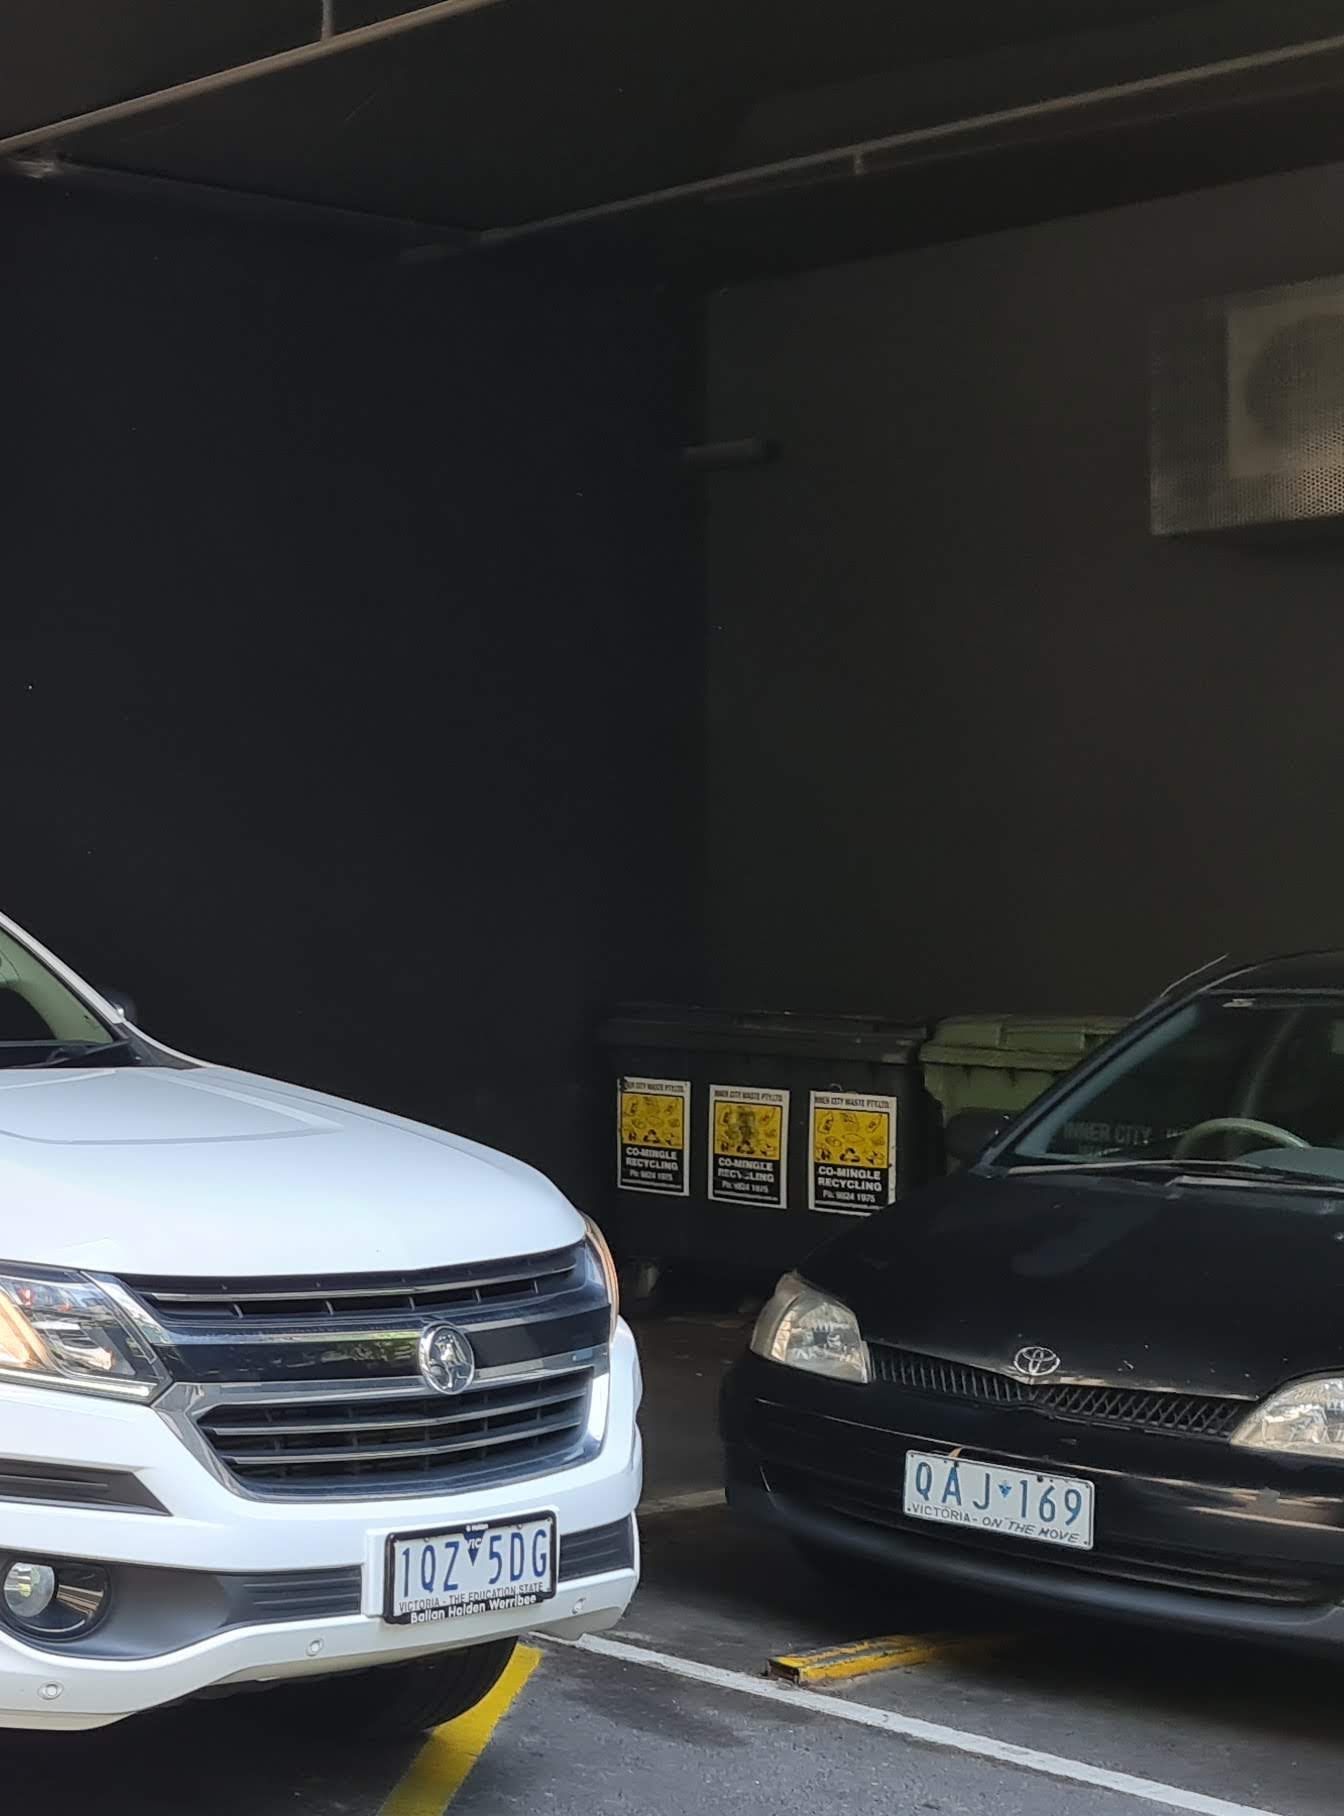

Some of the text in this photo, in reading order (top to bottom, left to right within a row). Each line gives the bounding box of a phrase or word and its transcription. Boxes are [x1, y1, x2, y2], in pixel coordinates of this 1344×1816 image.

[625, 1147, 677, 1160] CO-MINGLE
[625, 1157, 679, 1171] RECYCLING
[718, 1157, 773, 1171] CO-MINGLE
[818, 1166, 881, 1180] CO-MINGLE
[817, 1177, 882, 1191] RECYCLING
[982, 1516, 1002, 1528] ON
[1007, 1521, 1036, 1535] THE
[1038, 1527, 1080, 1544] MOVE
[466, 1538, 482, 1549] VIC
[399, 1597, 440, 1614] VICTORIA
[449, 1593, 466, 1605] THE
[468, 1586, 516, 1602] EDUCATION
[519, 1582, 543, 1593] STATE
[410, 1594, 537, 1624] Ballan Holden Werribee
